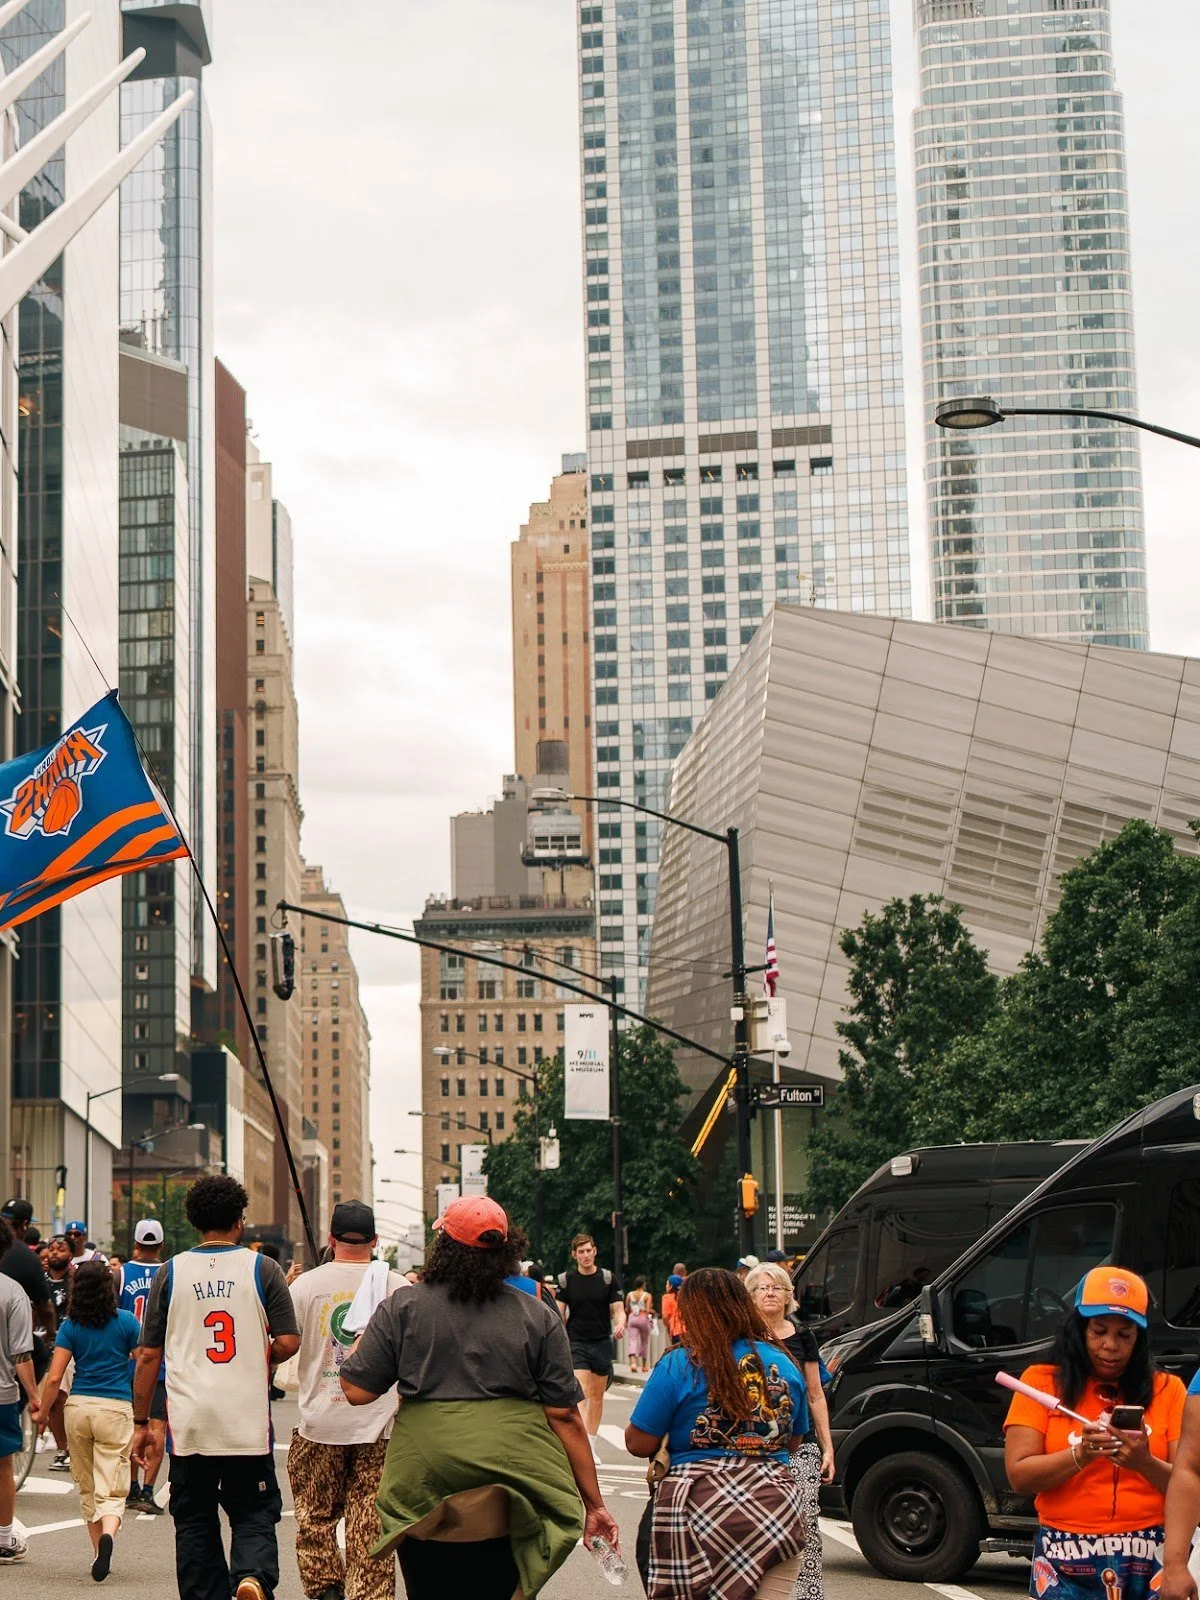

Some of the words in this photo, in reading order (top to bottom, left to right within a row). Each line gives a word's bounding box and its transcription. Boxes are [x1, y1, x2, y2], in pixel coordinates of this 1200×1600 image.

[577, 1049, 597, 1060] 9/11
[780, 1089, 813, 1102] Fulton
[124, 1277, 152, 1296] BRUN
[192, 1280, 235, 1301] HART
[203, 1309, 237, 1364] 3
[1041, 1536, 1163, 1561] CHAMPION
